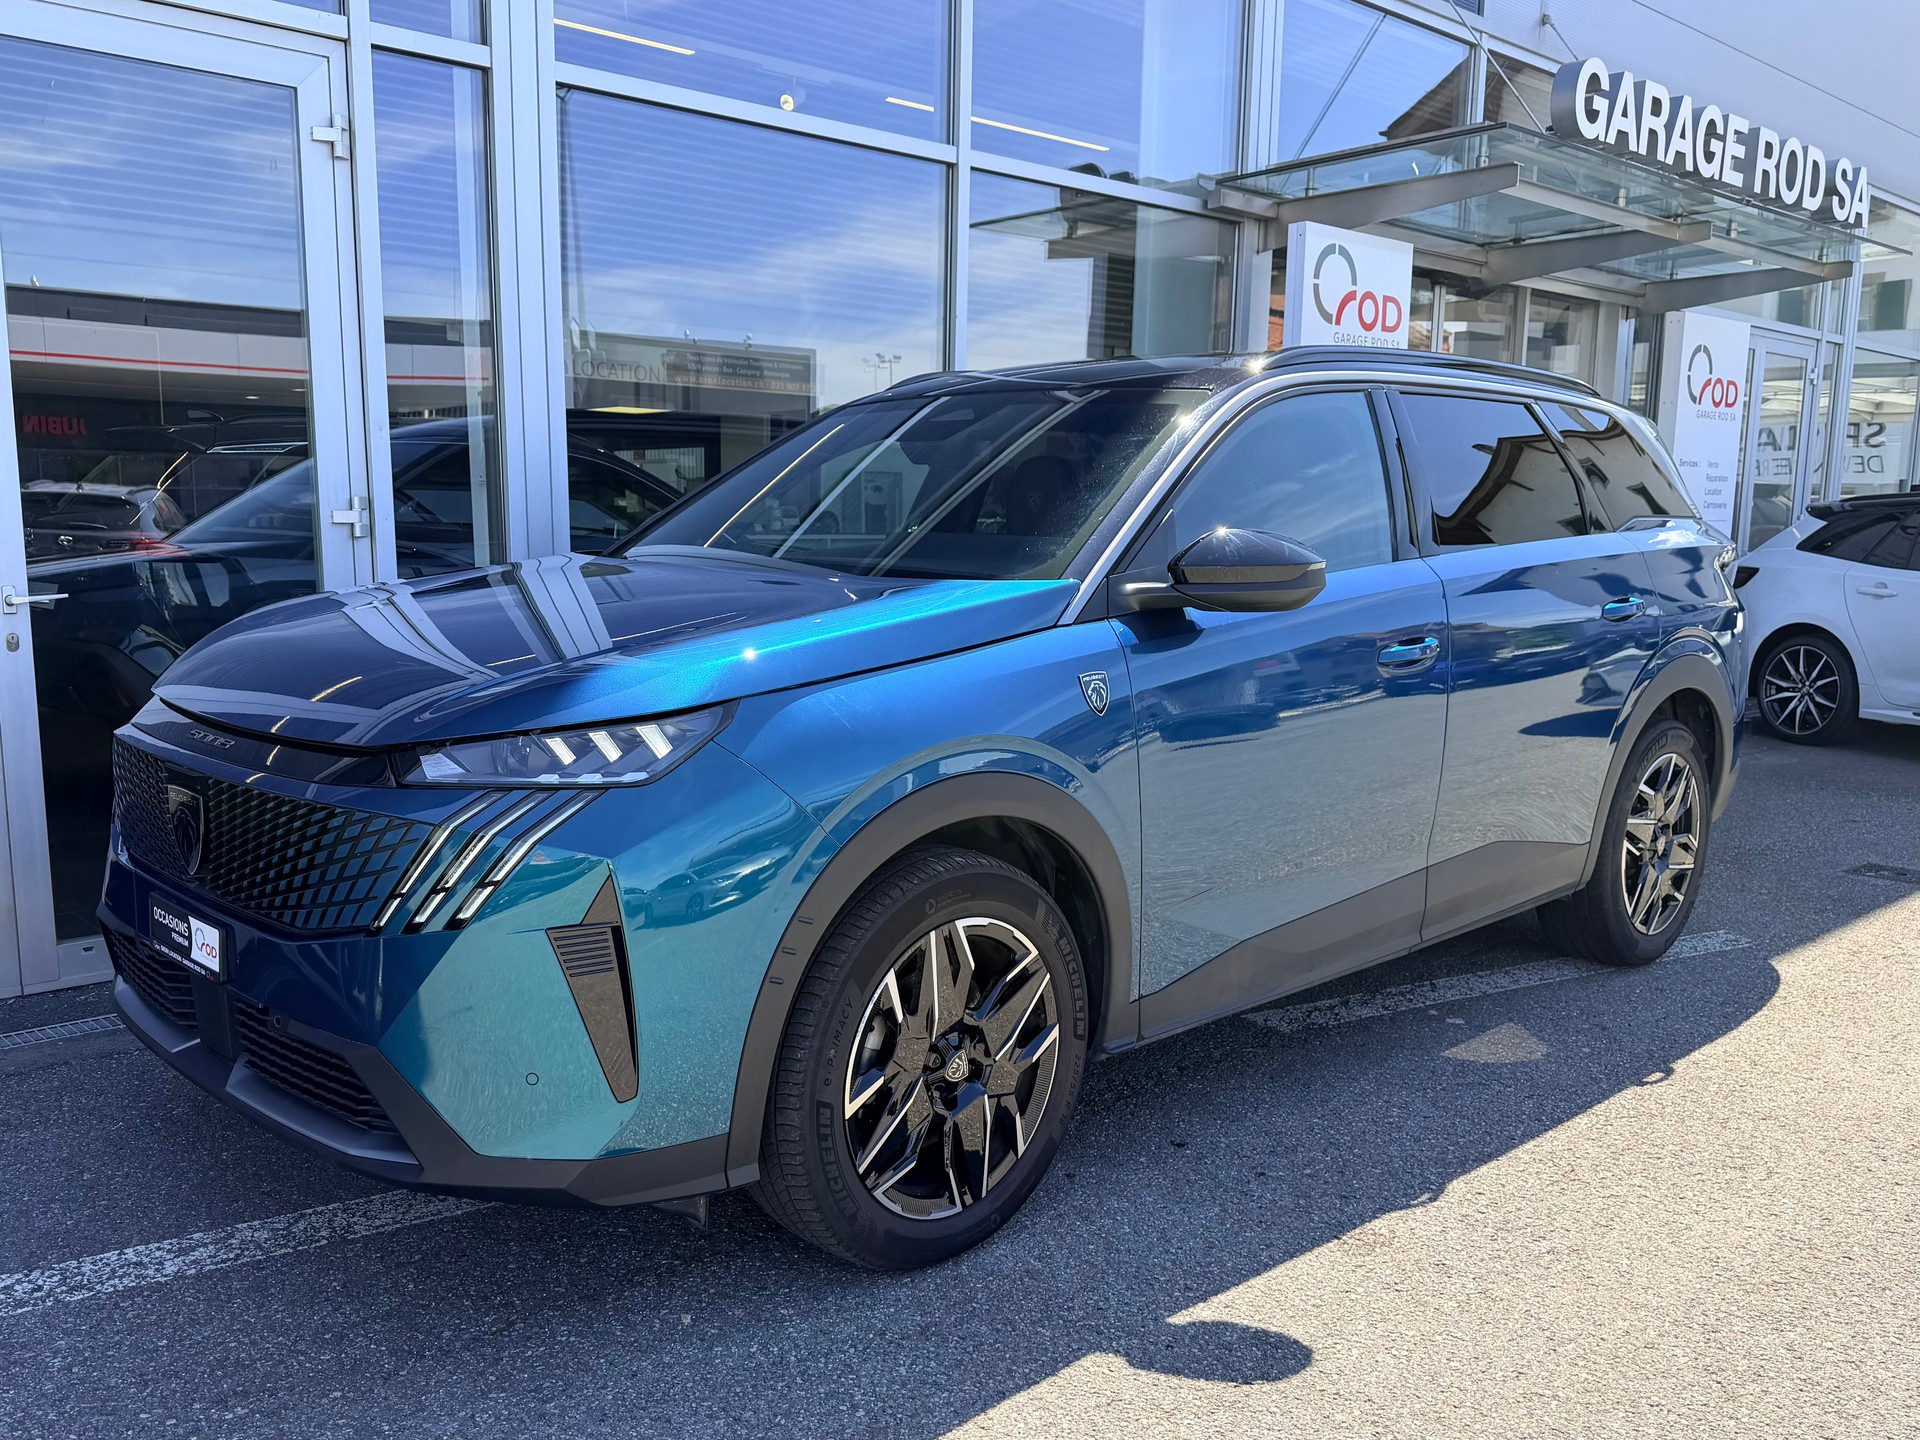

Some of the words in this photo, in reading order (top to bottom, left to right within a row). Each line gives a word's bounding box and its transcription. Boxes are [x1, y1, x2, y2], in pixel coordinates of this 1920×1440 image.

[1574, 56, 1750, 188] GARAGE
[1753, 126, 1826, 212] ROD
[1831, 157, 1868, 229] SA
[1333, 332, 1369, 347] GARAGE
[1371, 337, 1389, 348] ROD
[573, 360, 660, 382] LOCATION
[1696, 409, 1717, 421] GARAGE
[1717, 411, 1729, 421] ROD
[1729, 412, 1736, 422] SA
[1082, 674, 1105, 682] PEUGEOT
[169, 791, 197, 807] PEUGEOT
[153, 906, 189, 937] OCCASIONS
[171, 931, 189, 948] PREMIUM
[1058, 935, 1086, 1036] MICHELIN
[818, 1106, 859, 1217] MICHELIN
